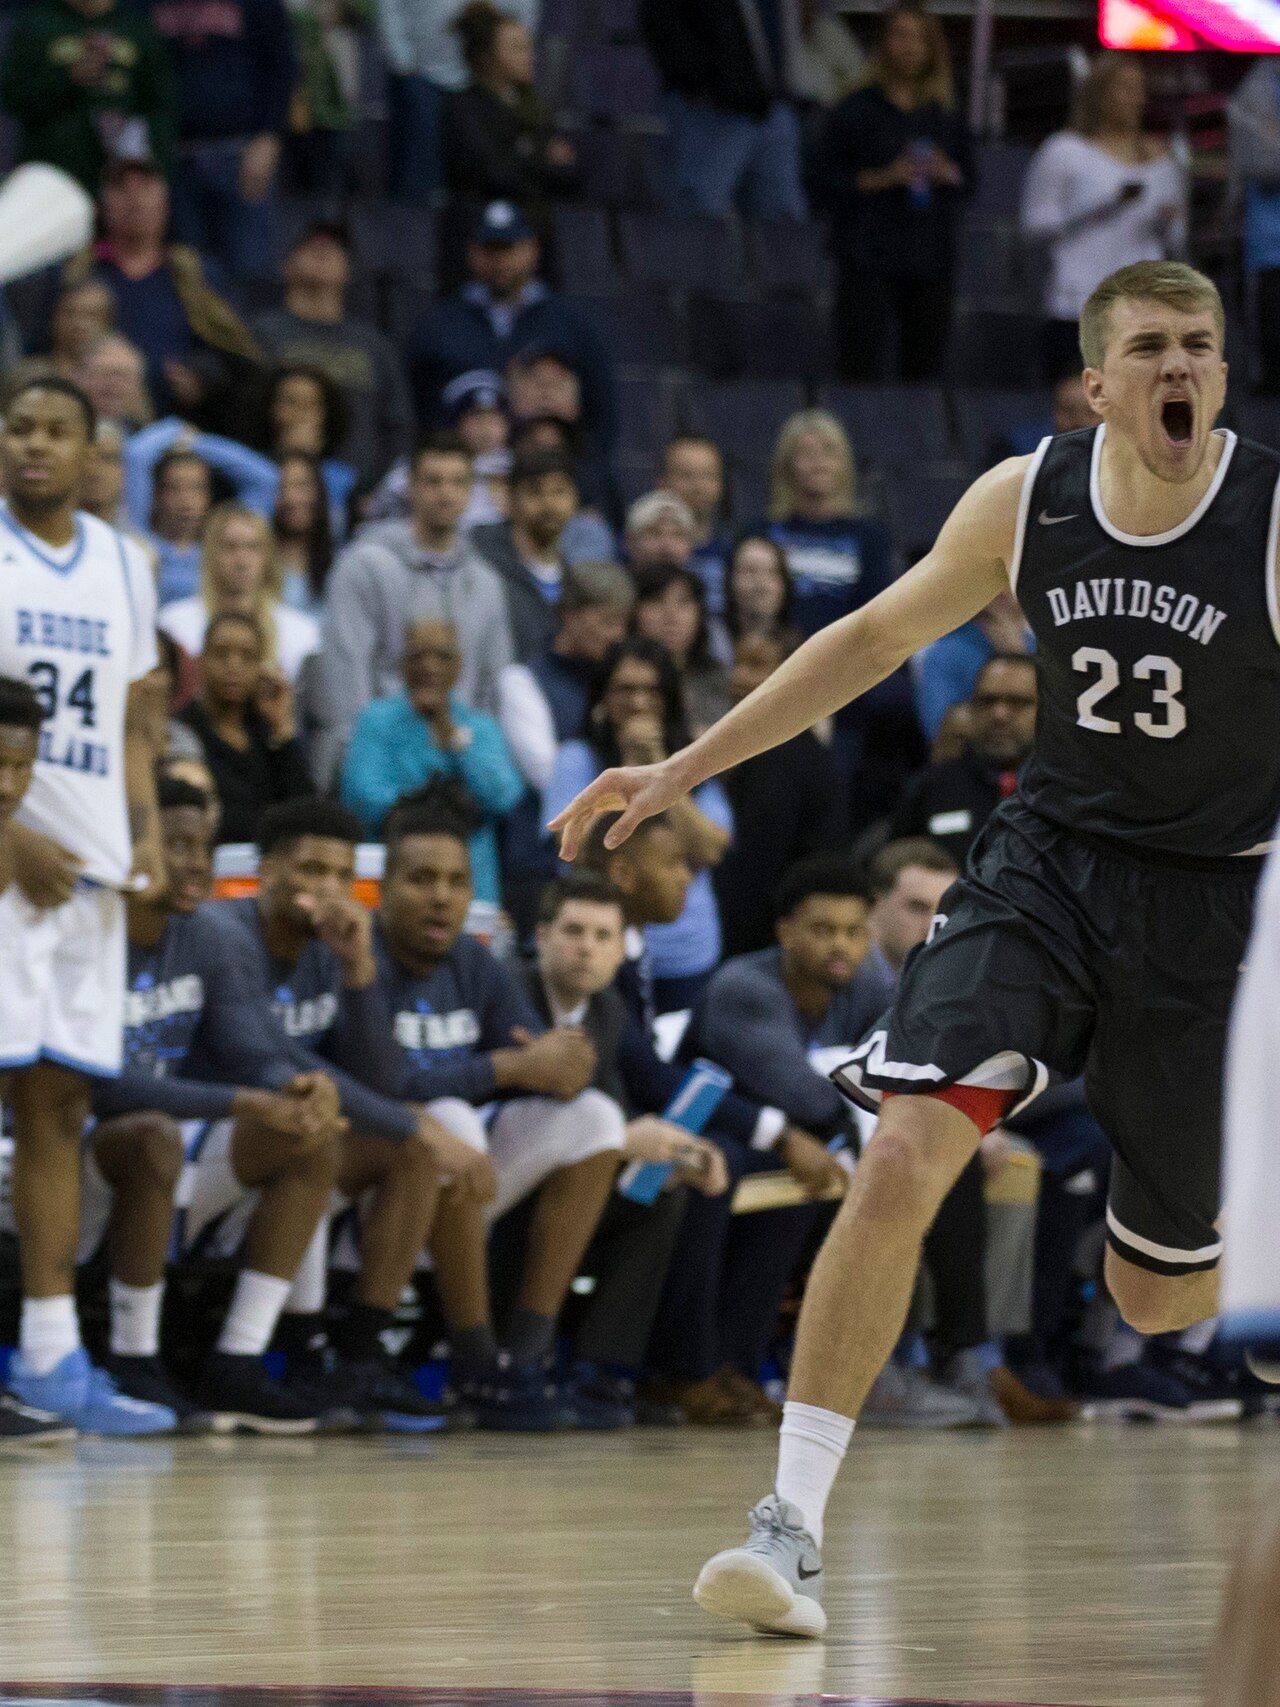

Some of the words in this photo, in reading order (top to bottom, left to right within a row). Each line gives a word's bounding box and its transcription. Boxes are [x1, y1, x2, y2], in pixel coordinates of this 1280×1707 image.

[1045, 577, 1229, 646] DAVIDSON
[27, 660, 97, 728] 34
[1071, 646, 1187, 739] 23
